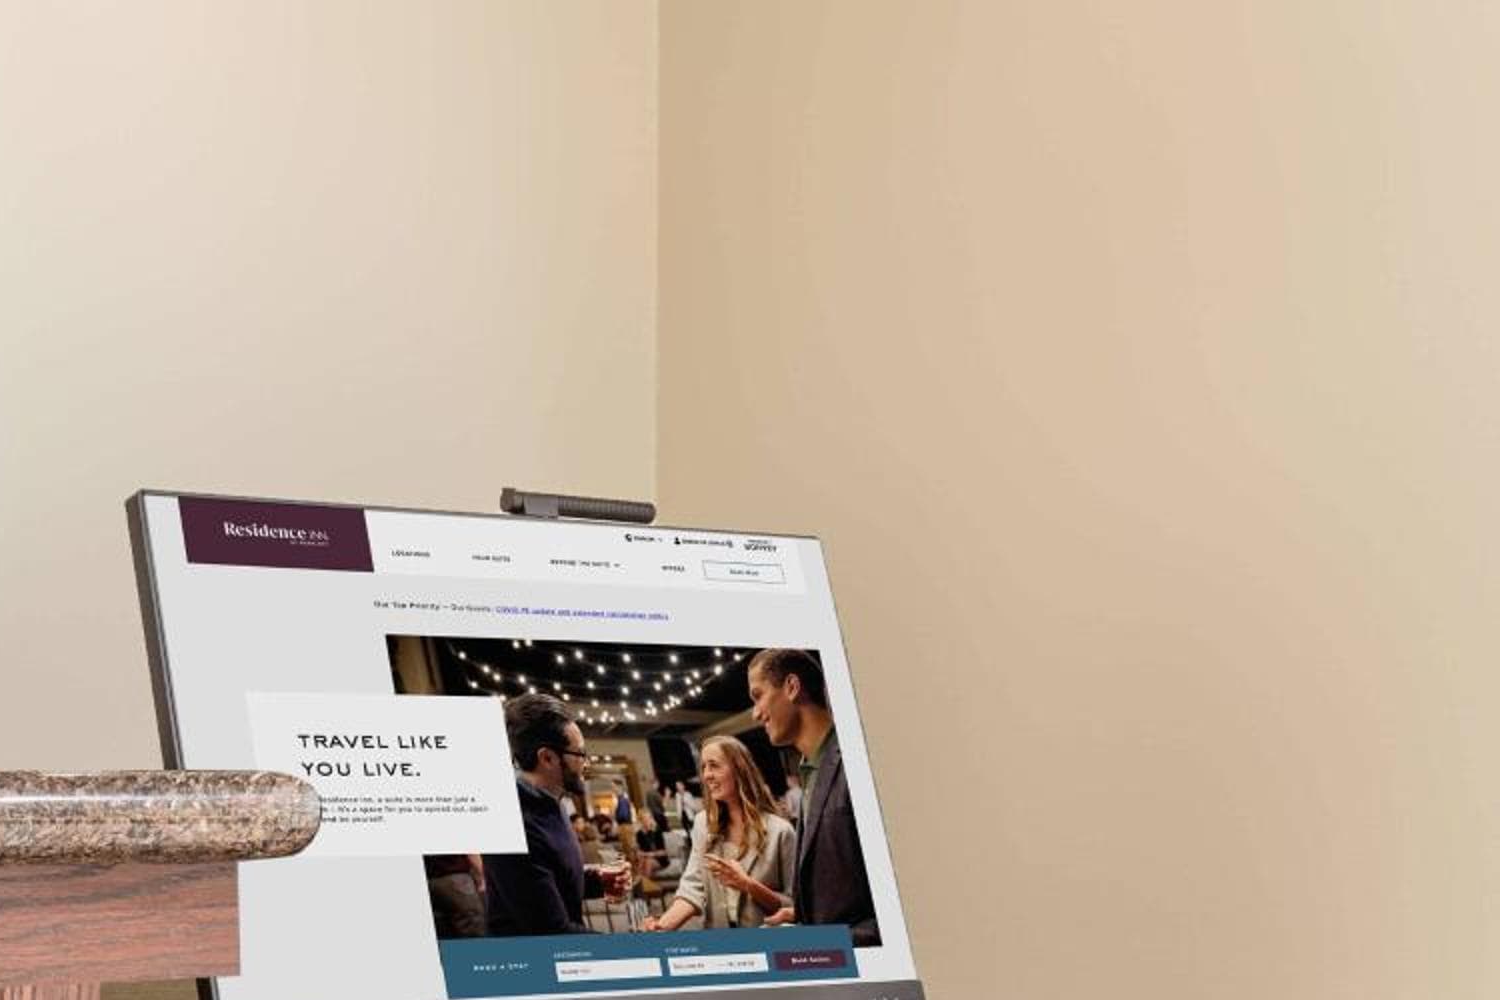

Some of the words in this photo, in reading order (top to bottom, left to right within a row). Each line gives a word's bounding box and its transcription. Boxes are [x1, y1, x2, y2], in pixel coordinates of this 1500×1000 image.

[223, 521, 307, 541] Residence
[298, 734, 389, 749] TRAVEL
[397, 735, 448, 749] LIKE
[301, 762, 351, 777] YOU
[363, 763, 421, 777] LIVE.
[359, 807, 383, 815] space
